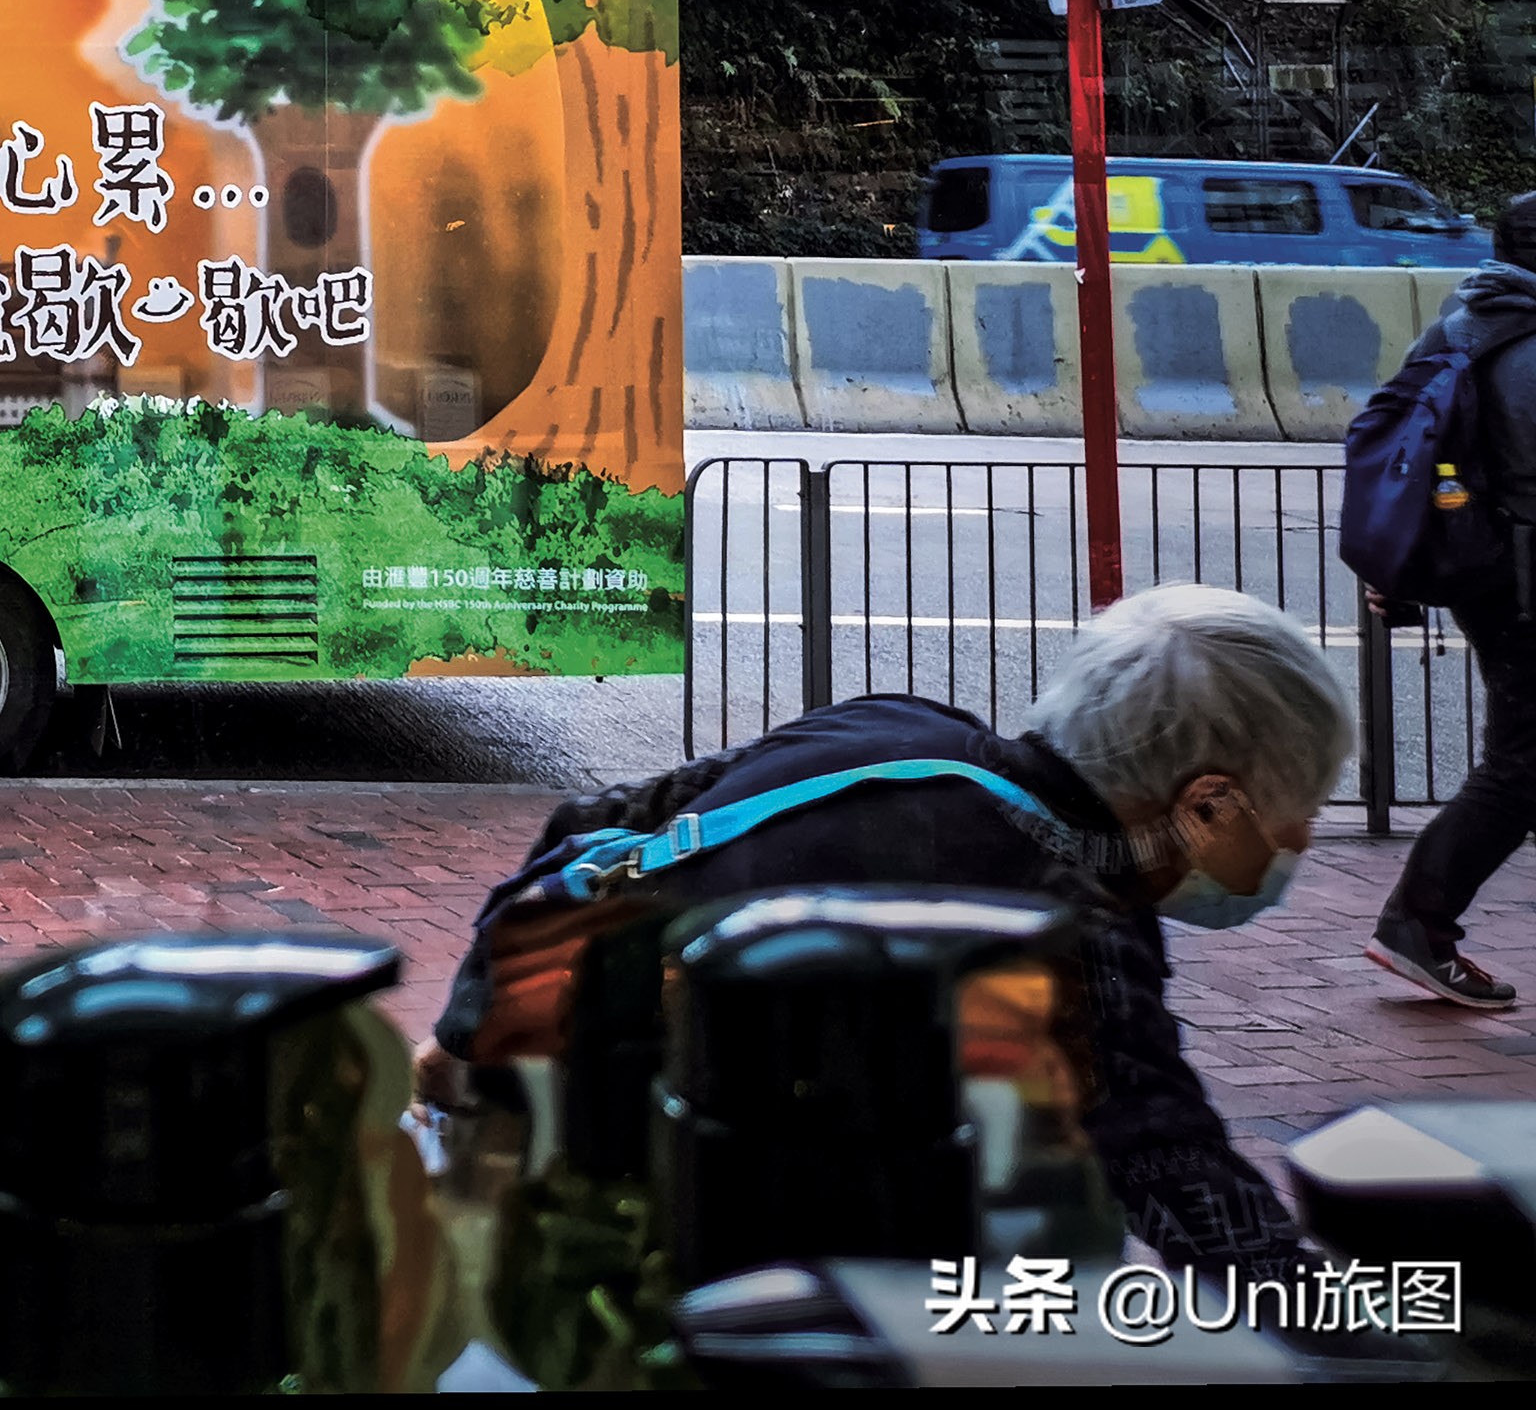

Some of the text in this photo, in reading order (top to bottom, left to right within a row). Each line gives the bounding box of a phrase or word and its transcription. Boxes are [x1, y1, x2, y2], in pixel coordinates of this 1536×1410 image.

[363, 599, 648, 613] Funded by the HSBC 150th Anniversary Charity Programme
